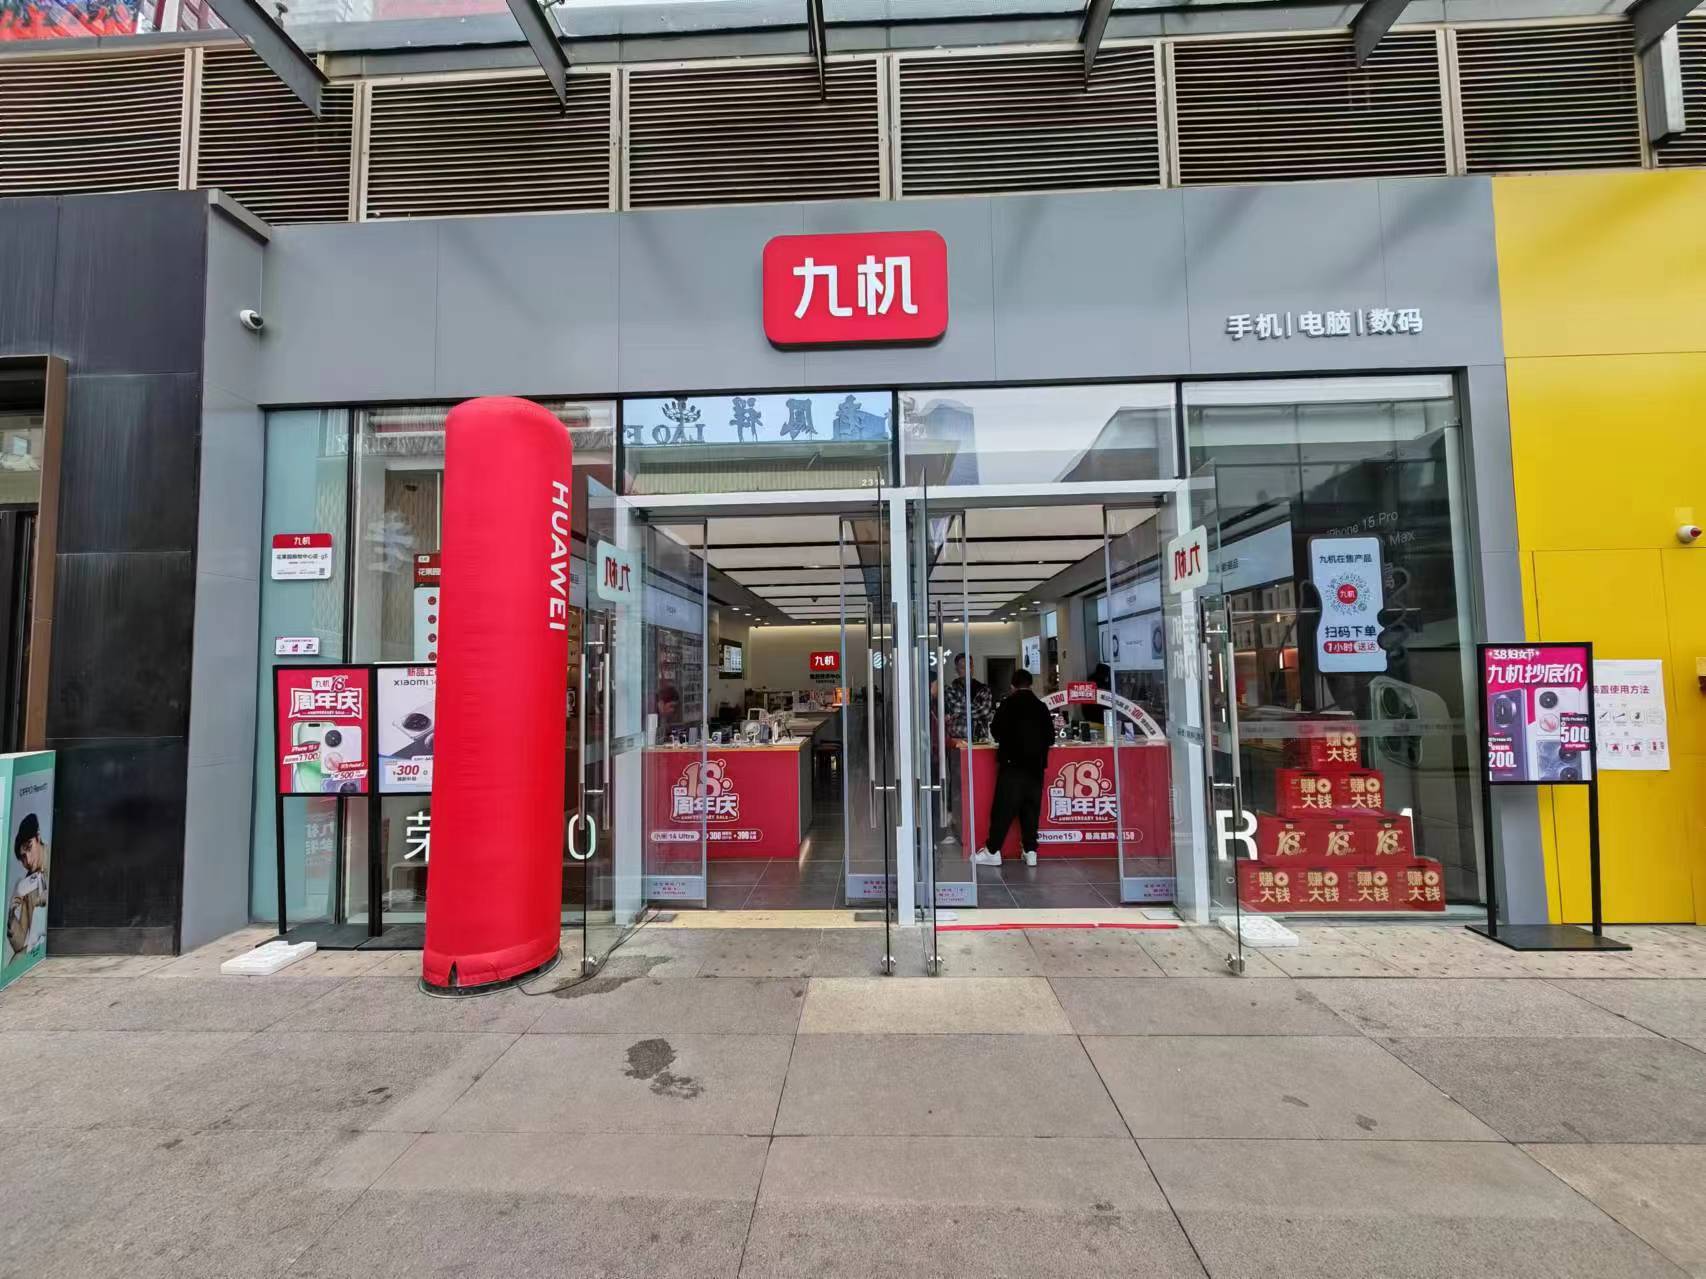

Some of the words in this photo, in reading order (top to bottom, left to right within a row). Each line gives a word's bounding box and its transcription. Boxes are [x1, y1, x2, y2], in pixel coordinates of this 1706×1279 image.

[793, 255, 919, 319] 九机
[1227, 313, 1283, 340] 手机
[1299, 310, 1351, 338] 电脑
[1366, 307, 1424, 336] 数码
[1378, 511, 1399, 526] Pro
[294, 536, 311, 546] 九机
[1389, 531, 1416, 546] Max
[549, 480, 569, 631] HUAWEI
[1319, 553, 1373, 564] 九机在售产品
[1339, 590, 1356, 599] 九机
[1324, 625, 1378, 639] 扫码下单
[1327, 642, 1354, 653] 1小时
[814, 655, 835, 666] 九机
[407, 668, 436, 677] 新品上
[1487, 663, 1584, 684] 九机抄底价
[315, 680, 330, 688] 九机
[293, 691, 359, 713] 周年庆
[1327, 747, 1357, 762] 大钱
[686, 763, 722, 798] 18
[1061, 763, 1100, 798] 18
[673, 796, 737, 817] 周年庆
[1050, 796, 1118, 818] 周年庆
[1302, 794, 1333, 809] 大钱
[1351, 794, 1382, 809] 大钱
[1260, 887, 1292, 902] 大钱
[1309, 888, 1341, 903] 大钱
[1358, 887, 1390, 902] 大钱
[1408, 887, 1440, 902] 大钱
